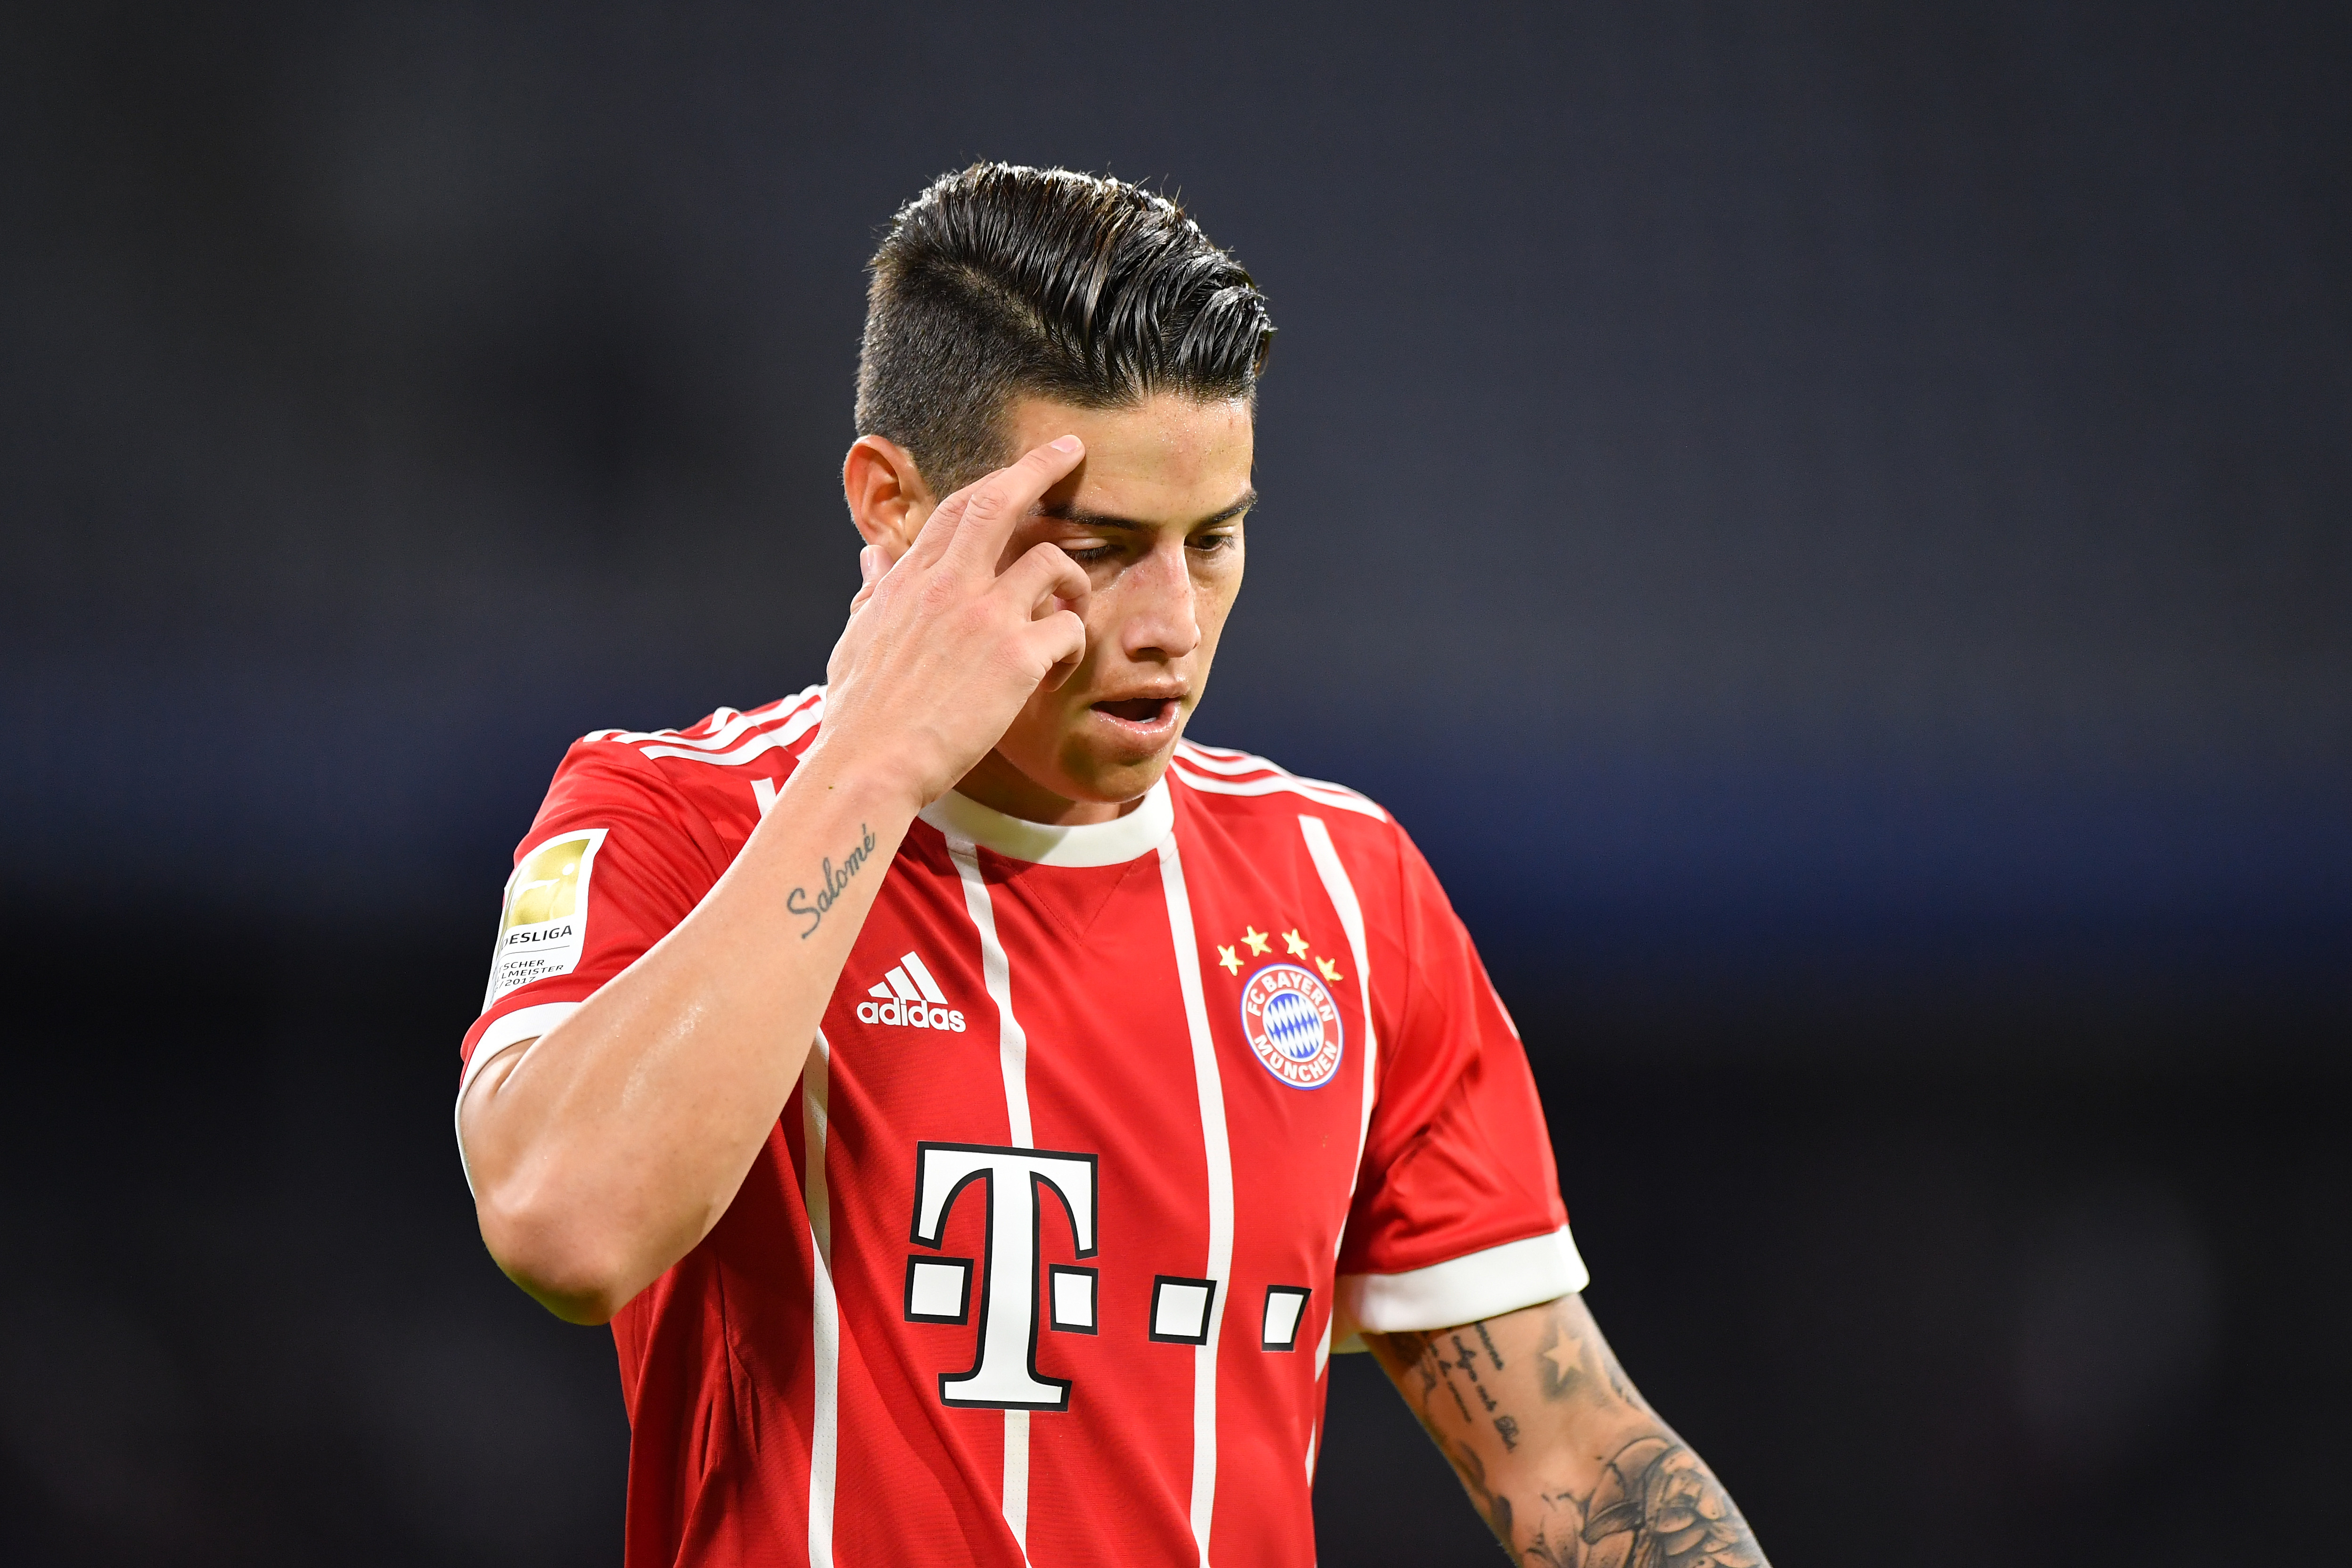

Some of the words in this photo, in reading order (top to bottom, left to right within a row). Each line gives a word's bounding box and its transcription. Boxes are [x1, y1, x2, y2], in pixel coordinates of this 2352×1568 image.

[787, 823, 876, 939] Salomé
[857, 997, 966, 1033] adidas
[1247, 988, 1266, 1017] FC
[1261, 972, 1335, 1022] BAYERN
